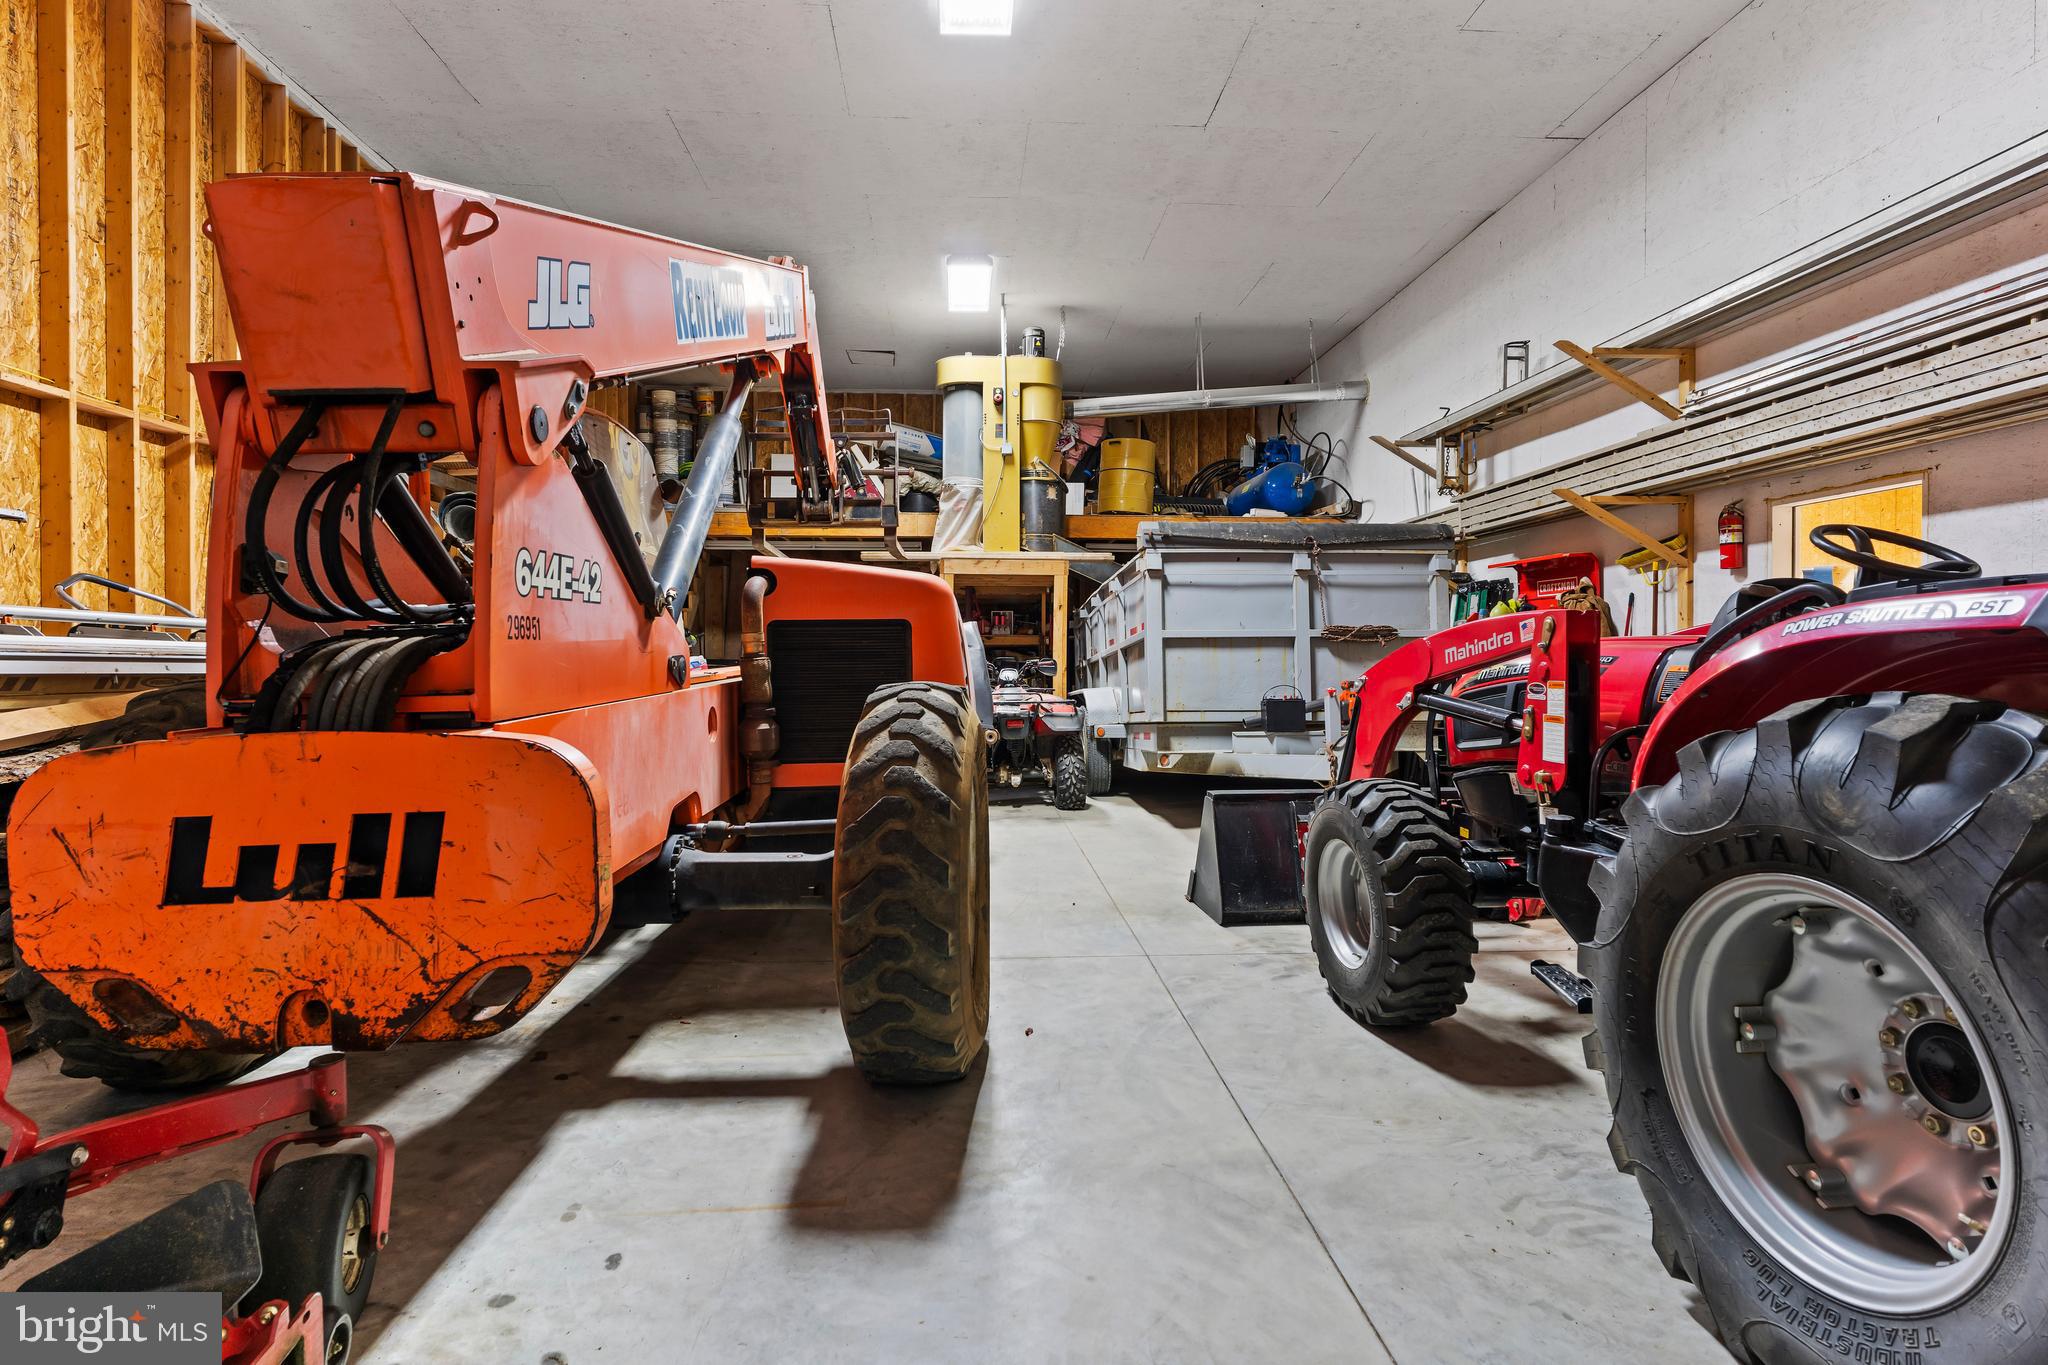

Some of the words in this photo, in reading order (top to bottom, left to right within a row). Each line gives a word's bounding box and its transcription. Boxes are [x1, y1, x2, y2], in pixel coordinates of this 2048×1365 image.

[515, 547, 602, 604] 644E-42
[1539, 581, 1576, 593] CRAFTSMAN
[507, 615, 541, 640] 296951
[1781, 613, 1844, 637] POWER
[1844, 603, 1930, 625] SHUTTLE
[1965, 599, 2012, 615] PST
[1444, 631, 1514, 664] Mahindra
[1685, 830, 1840, 877] TITAN
[1742, 1248, 1794, 1297] LUG
[1803, 1296, 1941, 1349] TRACTOR
